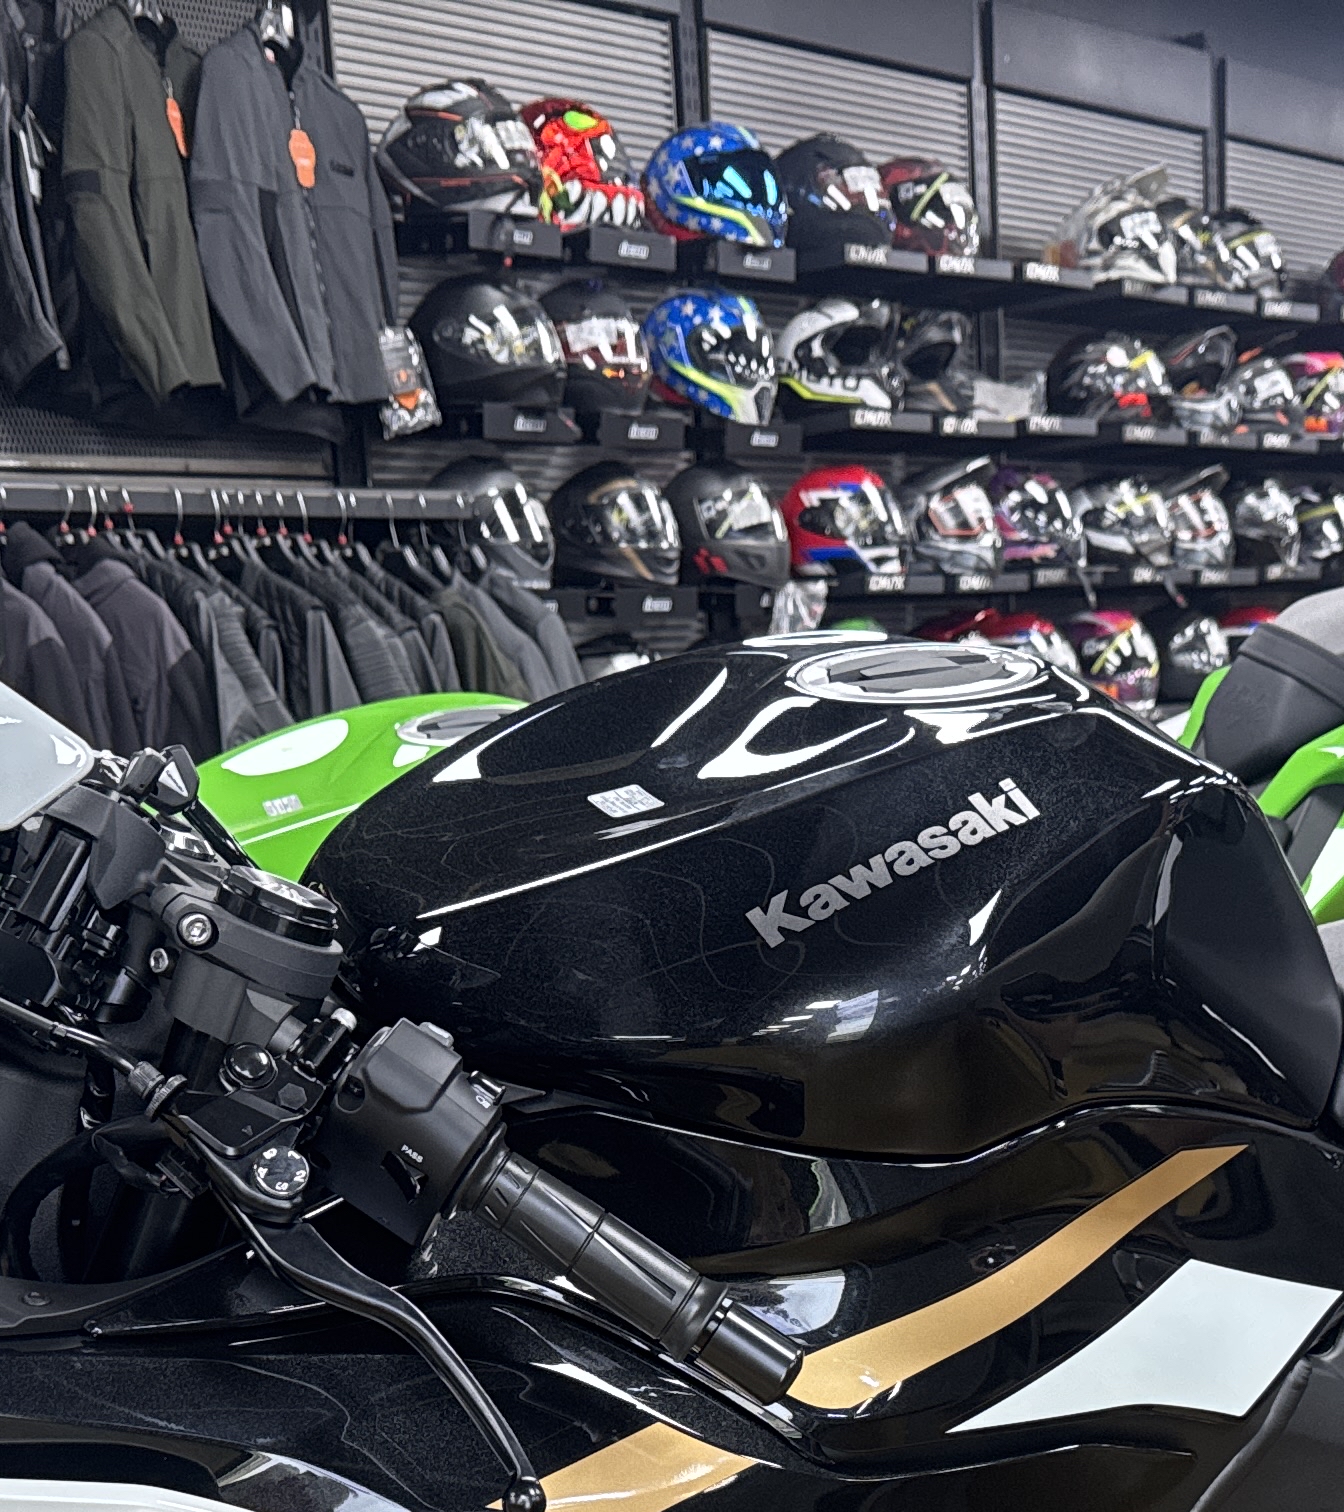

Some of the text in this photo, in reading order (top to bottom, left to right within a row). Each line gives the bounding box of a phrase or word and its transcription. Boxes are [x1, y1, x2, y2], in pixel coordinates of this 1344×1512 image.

[745, 777, 1041, 949] Kawasaki
[400, 1143, 424, 1164] PASS
[293, 1169, 307, 1183] 2
